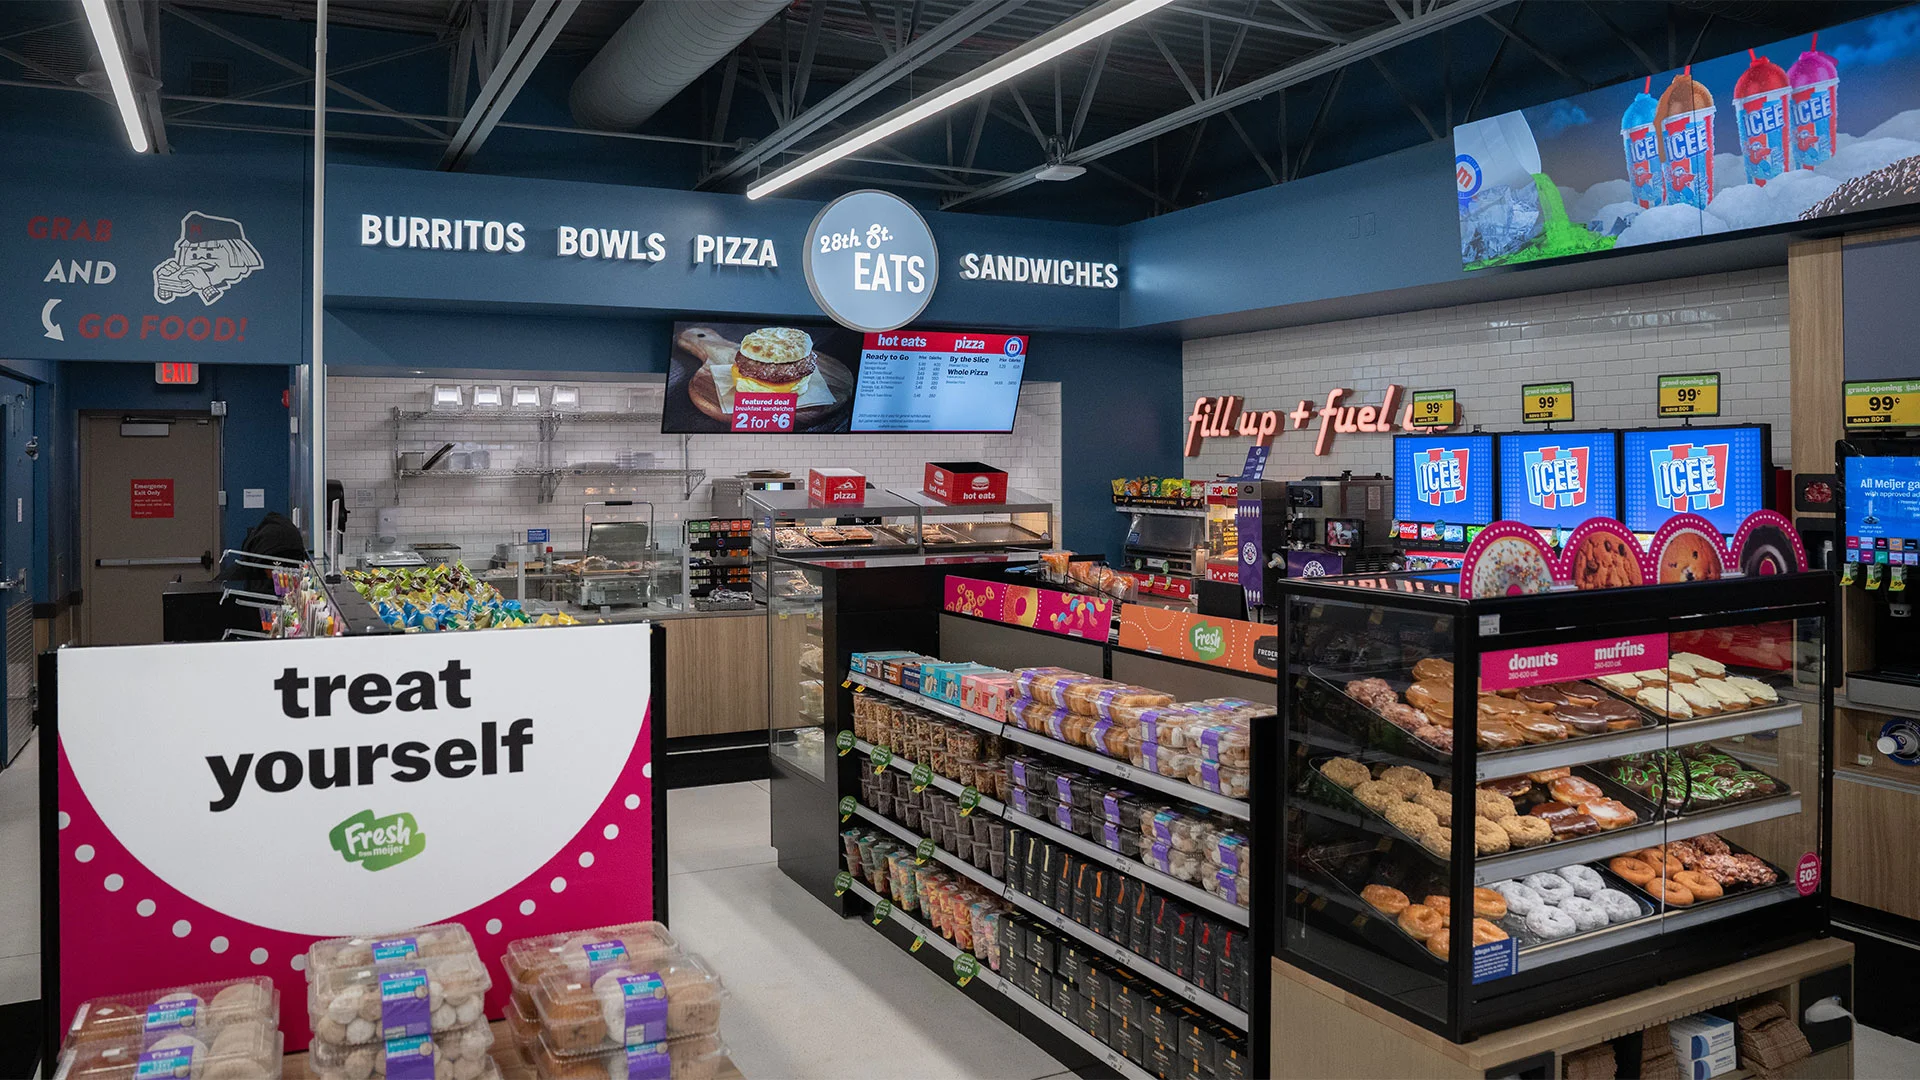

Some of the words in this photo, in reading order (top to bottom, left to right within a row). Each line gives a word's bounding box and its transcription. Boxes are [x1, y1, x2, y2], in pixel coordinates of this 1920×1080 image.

[1745, 103, 1784, 136] ICEE
[1793, 95, 1832, 126] ICEE
[1630, 134, 1659, 162] ICE
[1666, 126, 1708, 161] ICEE
[27, 215, 113, 243] GRAB
[361, 213, 526, 253] BURRITOS
[820, 228, 861, 254] 28th
[865, 223, 894, 250] St.
[557, 225, 667, 263] BOWLS
[694, 233, 778, 269] PIZZA
[43, 258, 117, 285] AND
[854, 251, 926, 294] EATS
[961, 253, 1119, 289] SANDWICHES
[78, 313, 130, 340] GO
[139, 314, 248, 342] FOOD!
[877, 333, 899, 347] hot
[900, 335, 927, 348] eats
[954, 336, 985, 351] pizza
[865, 352, 889, 362] Ready
[950, 356, 958, 364] By
[162, 362, 193, 383] EXIT
[970, 368, 988, 376] Pizza
[1677, 388, 1701, 402] 99¢
[1847, 386, 1870, 395] grand
[1870, 384, 1903, 393] opening
[1538, 396, 1559, 409] 99¢
[1868, 395, 1901, 412] 99¢
[735, 413, 749, 429] 2
[750, 416, 770, 429] for
[772, 413, 791, 429] $6
[1184, 396, 1237, 458] fill
[1238, 410, 1278, 447] up
[1290, 400, 1310, 430] +
[1314, 384, 1396, 457] fuel
[1420, 457, 1463, 494] ICEE
[1530, 457, 1582, 496] ICEE
[1659, 455, 1719, 499] ICEE
[1860, 478, 1873, 489] All
[1874, 478, 1906, 491] Meijer
[833, 492, 857, 501] pizza
[963, 492, 976, 500] hot
[1194, 627, 1221, 649] Fresh
[1508, 652, 1559, 671] donuts
[1594, 640, 1645, 661] muffins
[273, 659, 472, 719] treat
[206, 718, 534, 813] yourself
[344, 816, 411, 855] Fresh
[373, 844, 404, 857] meijer
[389, 970, 416, 979] Fresh
[626, 974, 650, 982] Fresh
